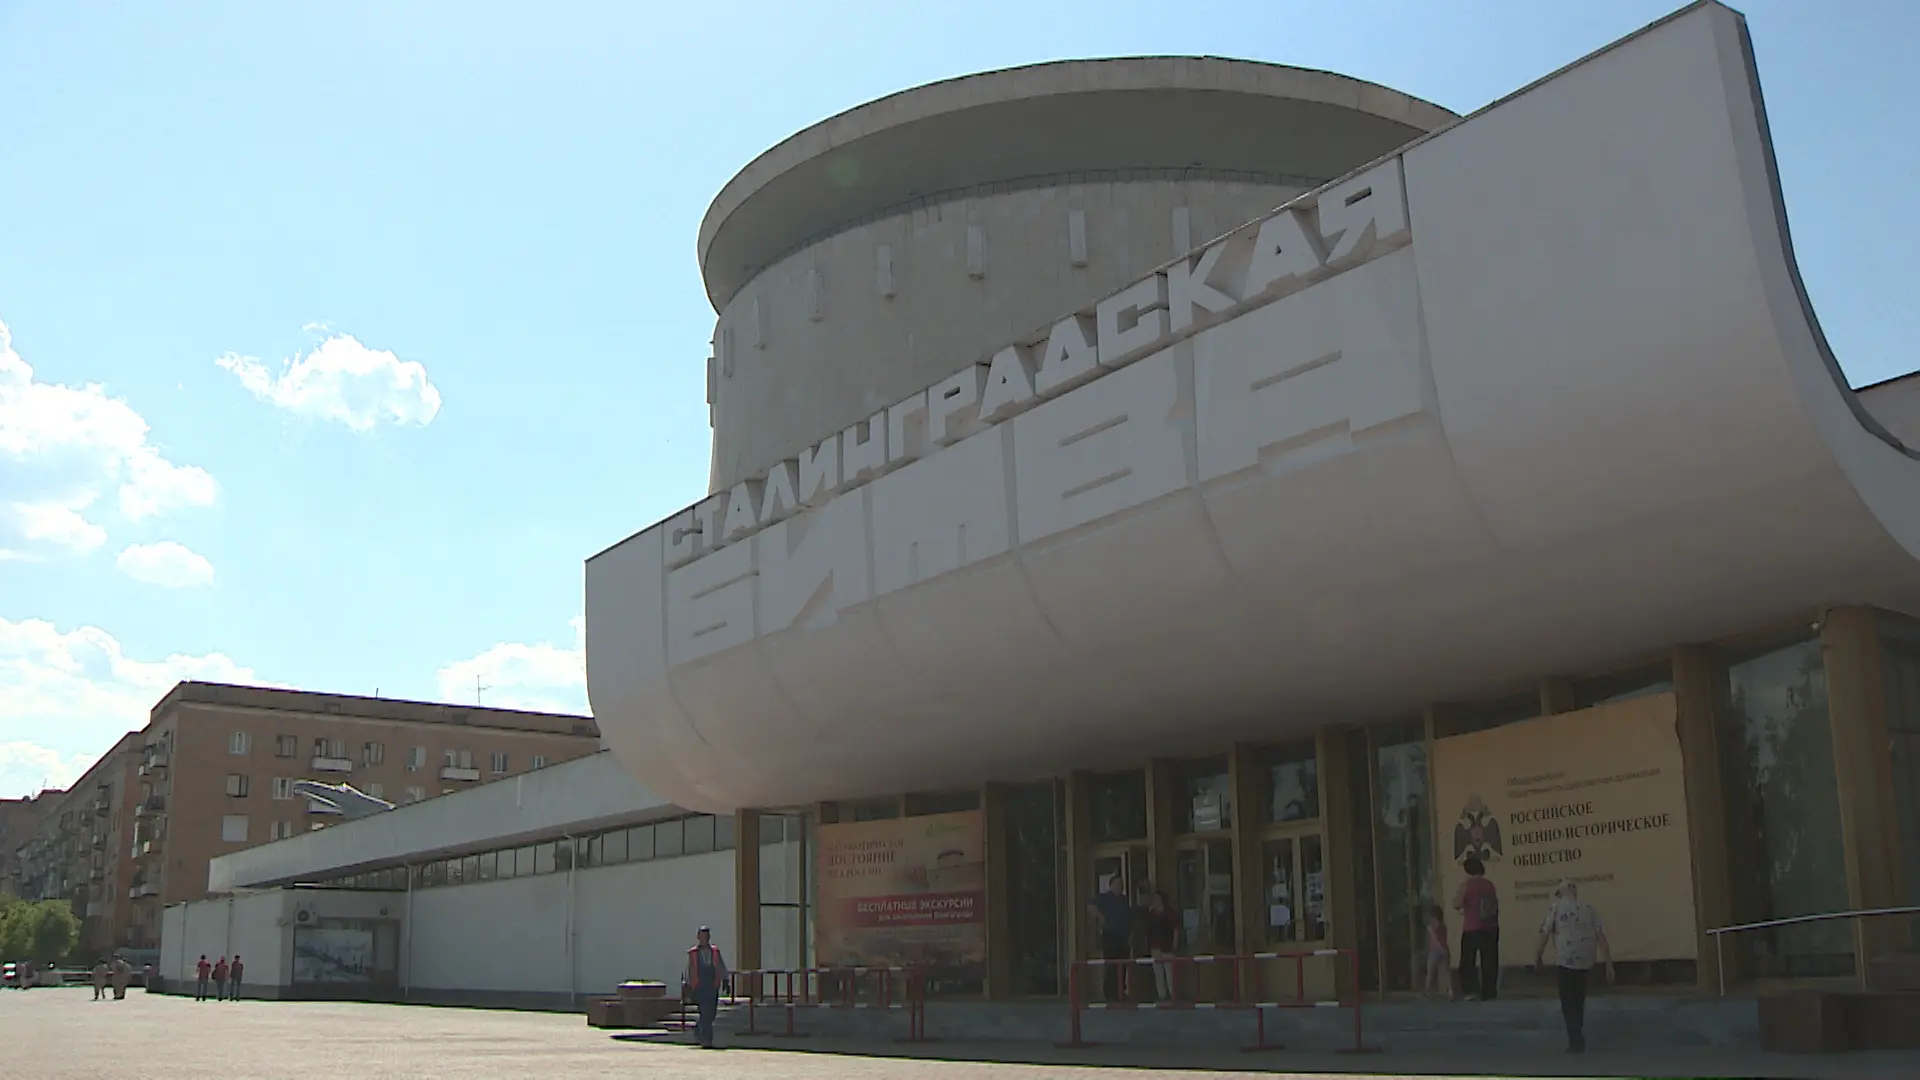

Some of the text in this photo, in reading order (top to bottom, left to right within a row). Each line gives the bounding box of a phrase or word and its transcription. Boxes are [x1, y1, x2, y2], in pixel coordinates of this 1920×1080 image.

[664, 156, 1410, 569] СТАЛИНГРАДСКАЯ
[667, 246, 1425, 668] БИТВА
[1509, 801, 1594, 825] РОССИЙСКОЕ
[1511, 813, 1670, 847] ВОЕННО-ИСТОРИЧЕСКОЕ
[1512, 847, 1582, 868] ОБЩЕСТВО
[857, 900, 917, 912] БЕСПЛАТНЫЕ
